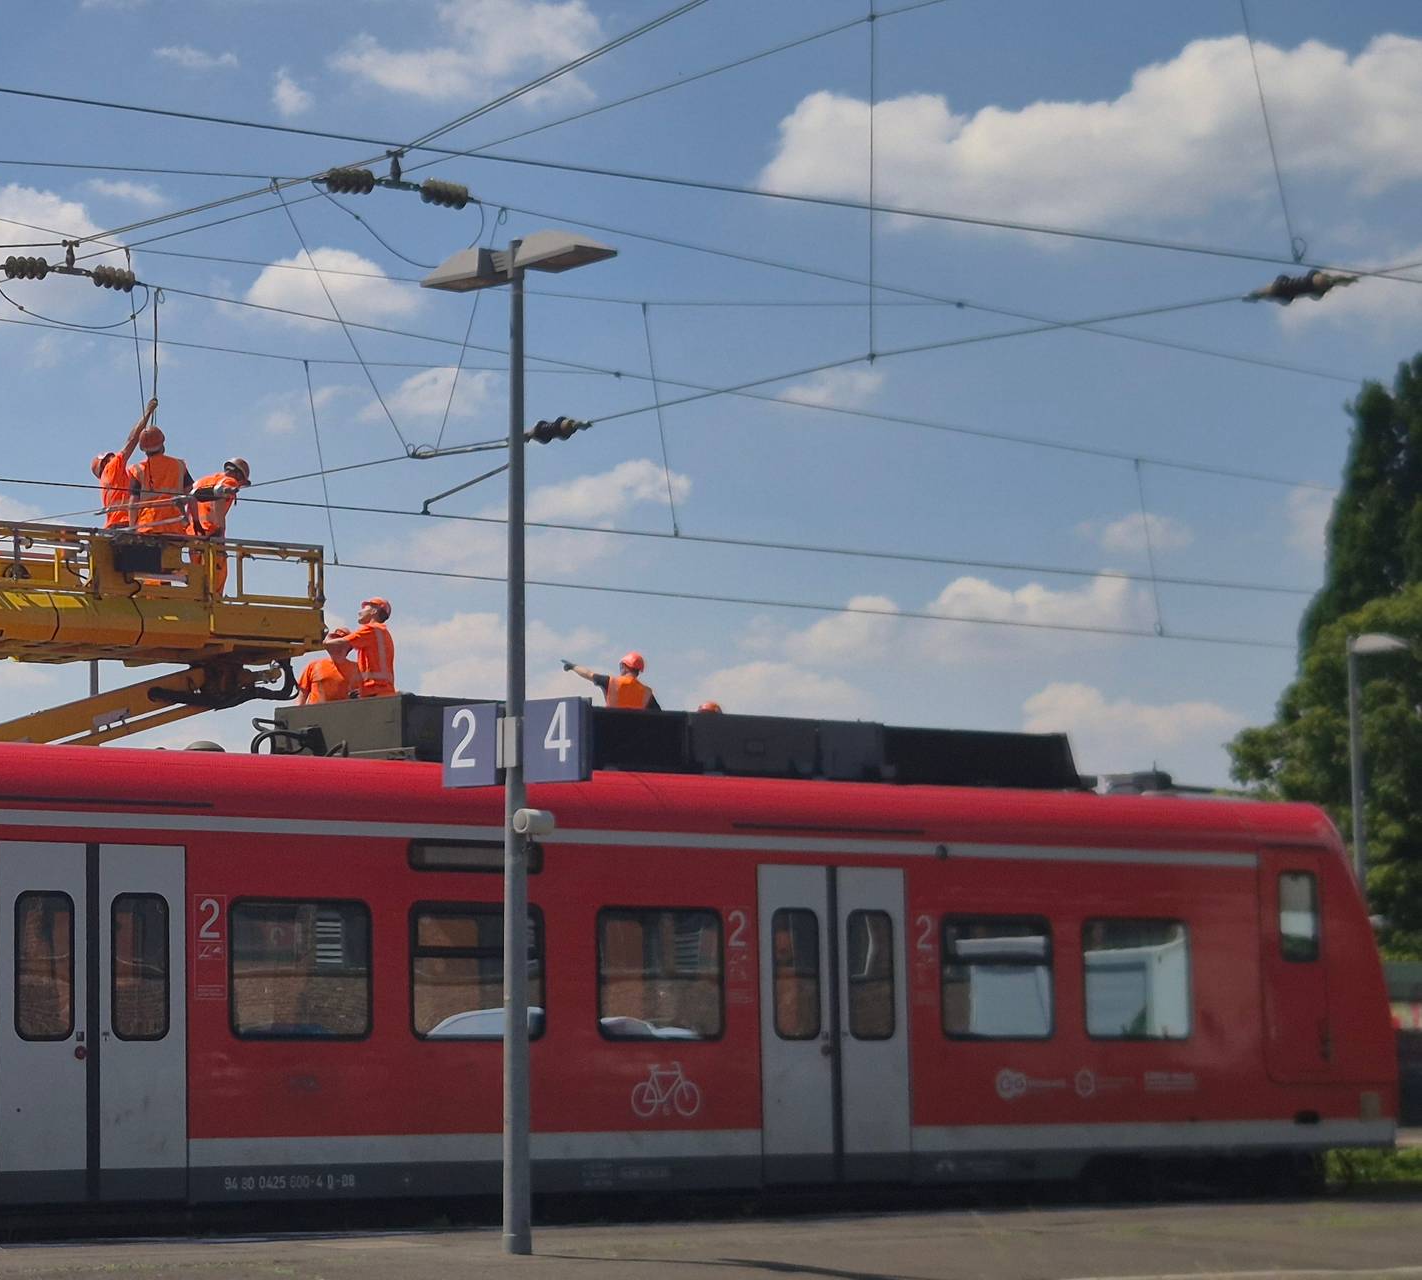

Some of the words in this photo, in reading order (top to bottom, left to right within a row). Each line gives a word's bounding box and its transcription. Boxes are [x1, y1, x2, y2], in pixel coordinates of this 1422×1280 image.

[450, 708, 476, 768] 2
[544, 701, 571, 762] 4
[199, 898, 220, 938] 2
[728, 910, 746, 947] 2
[916, 915, 932, 949] 2
[224, 1176, 238, 1190] 94
[258, 1175, 286, 1190] 0425
